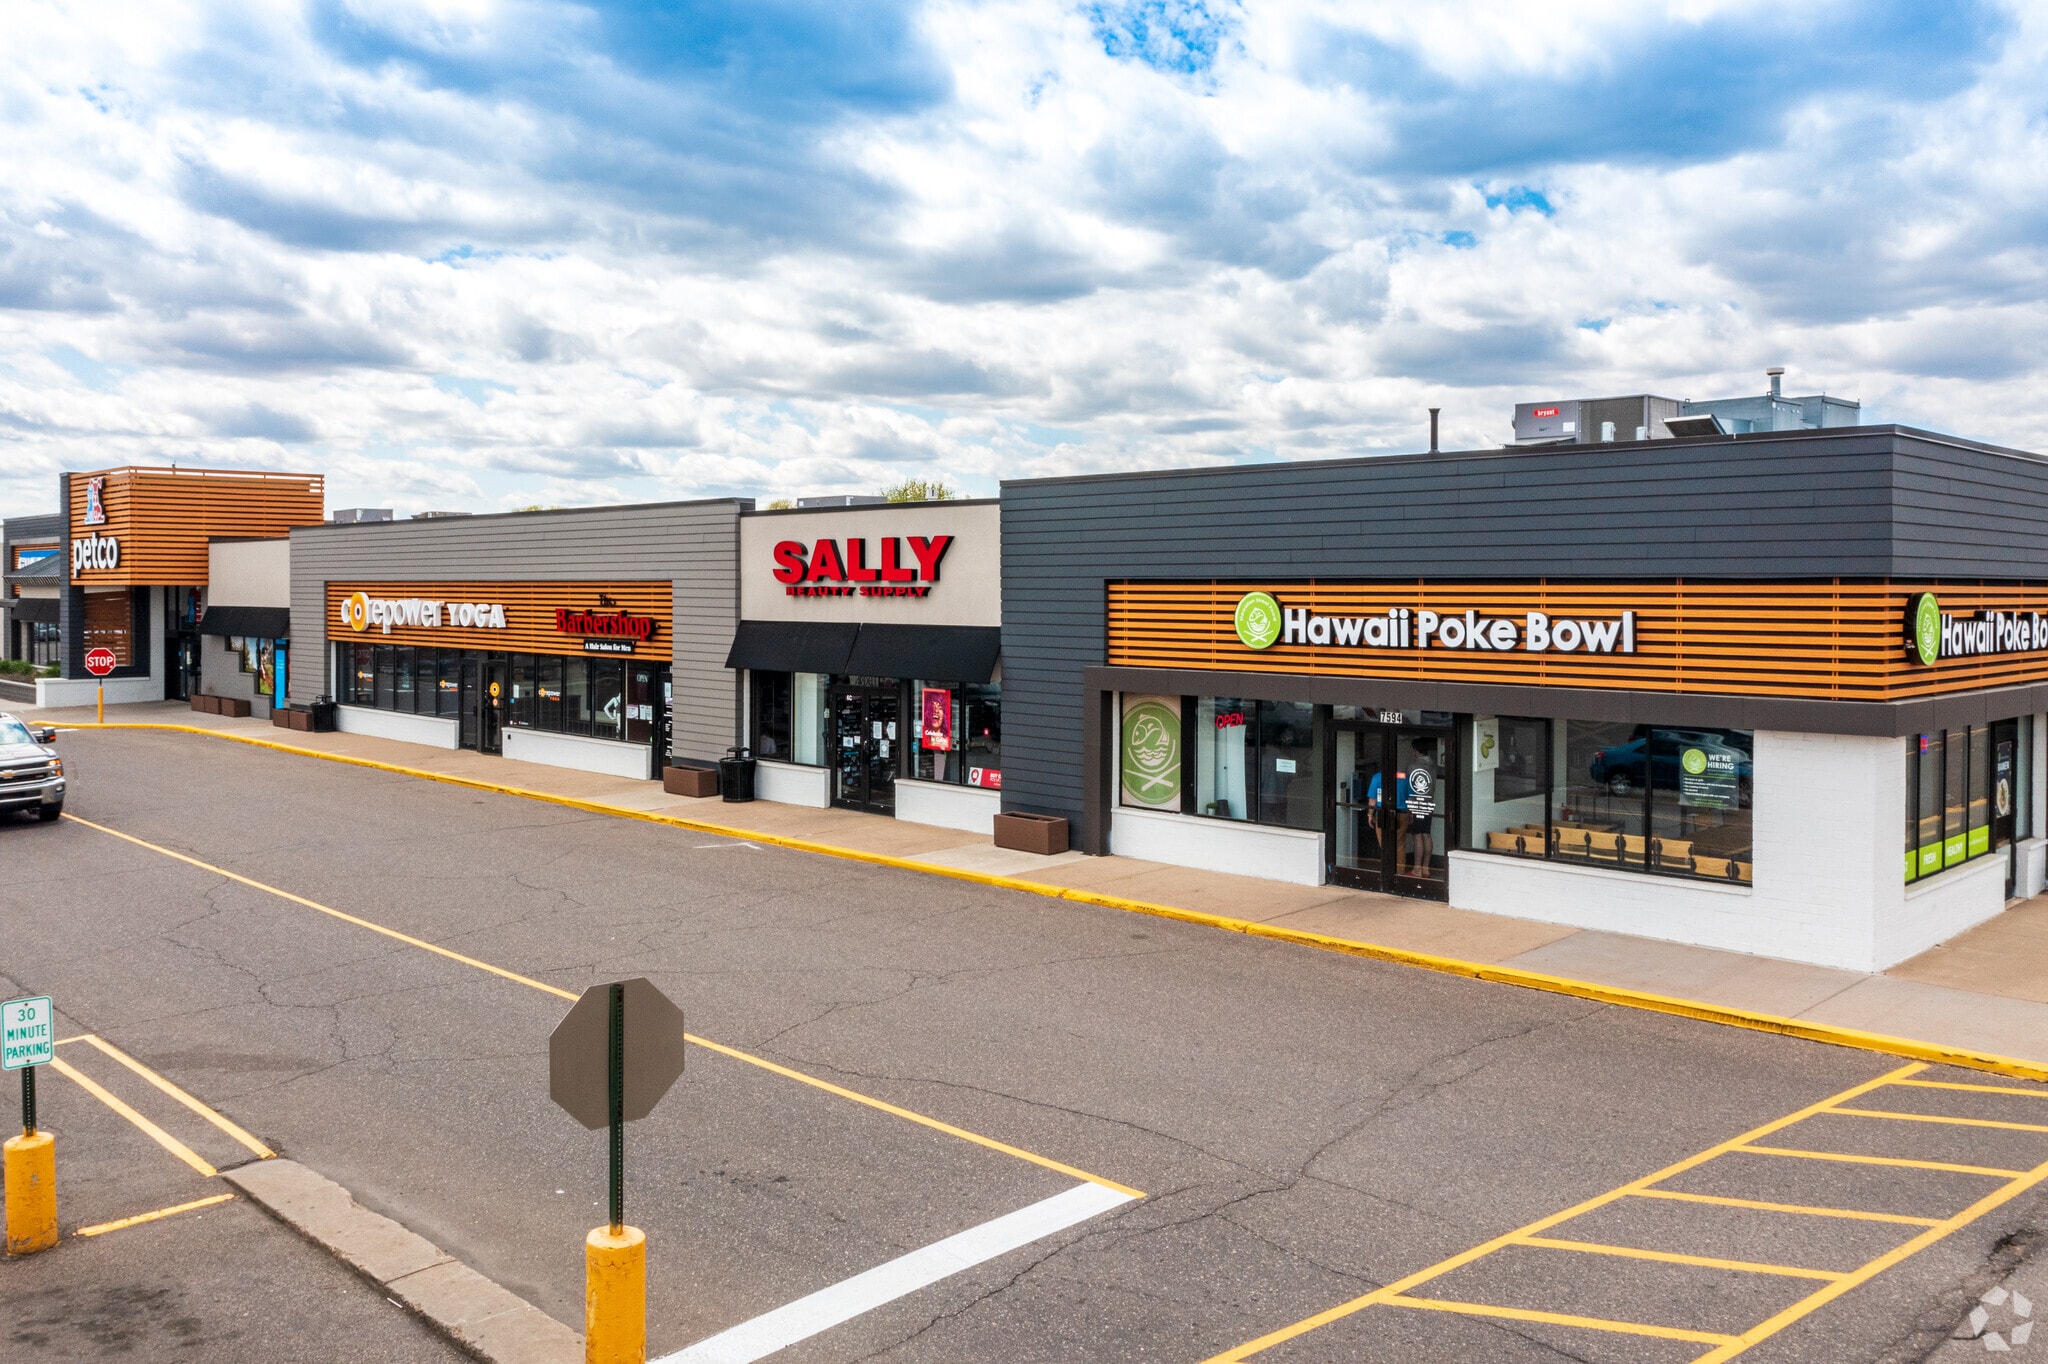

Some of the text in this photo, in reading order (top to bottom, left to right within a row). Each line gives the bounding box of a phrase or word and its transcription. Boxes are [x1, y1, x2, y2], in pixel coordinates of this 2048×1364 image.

[1537, 409, 1555, 417] bryant
[73, 531, 118, 580] petco
[772, 535, 953, 585] SALLY
[786, 586, 930, 597] BEAUTY SUPPLY
[341, 592, 508, 635] corepower YOGA
[555, 608, 652, 642] Barbershop
[1284, 608, 1634, 653] Hawaii Poke Bowl
[1941, 609, 1994, 657] Hawaii
[1996, 611, 2031, 652] Poke
[2032, 611, 2048, 650] Bo
[599, 643, 612, 651] Salon
[87, 656, 114, 667] STOP
[636, 674, 648, 682] OPEN
[1215, 713, 1244, 730] OPEN
[1381, 712, 1401, 723] 7594
[1707, 761, 1735, 770] HIRING
[1708, 754, 1731, 762] WE'RE
[1923, 852, 1937, 865] FRESH
[18, 1007, 36, 1022] 30
[7, 1024, 48, 1041] MINUTE
[6, 1041, 50, 1059] PARKING
